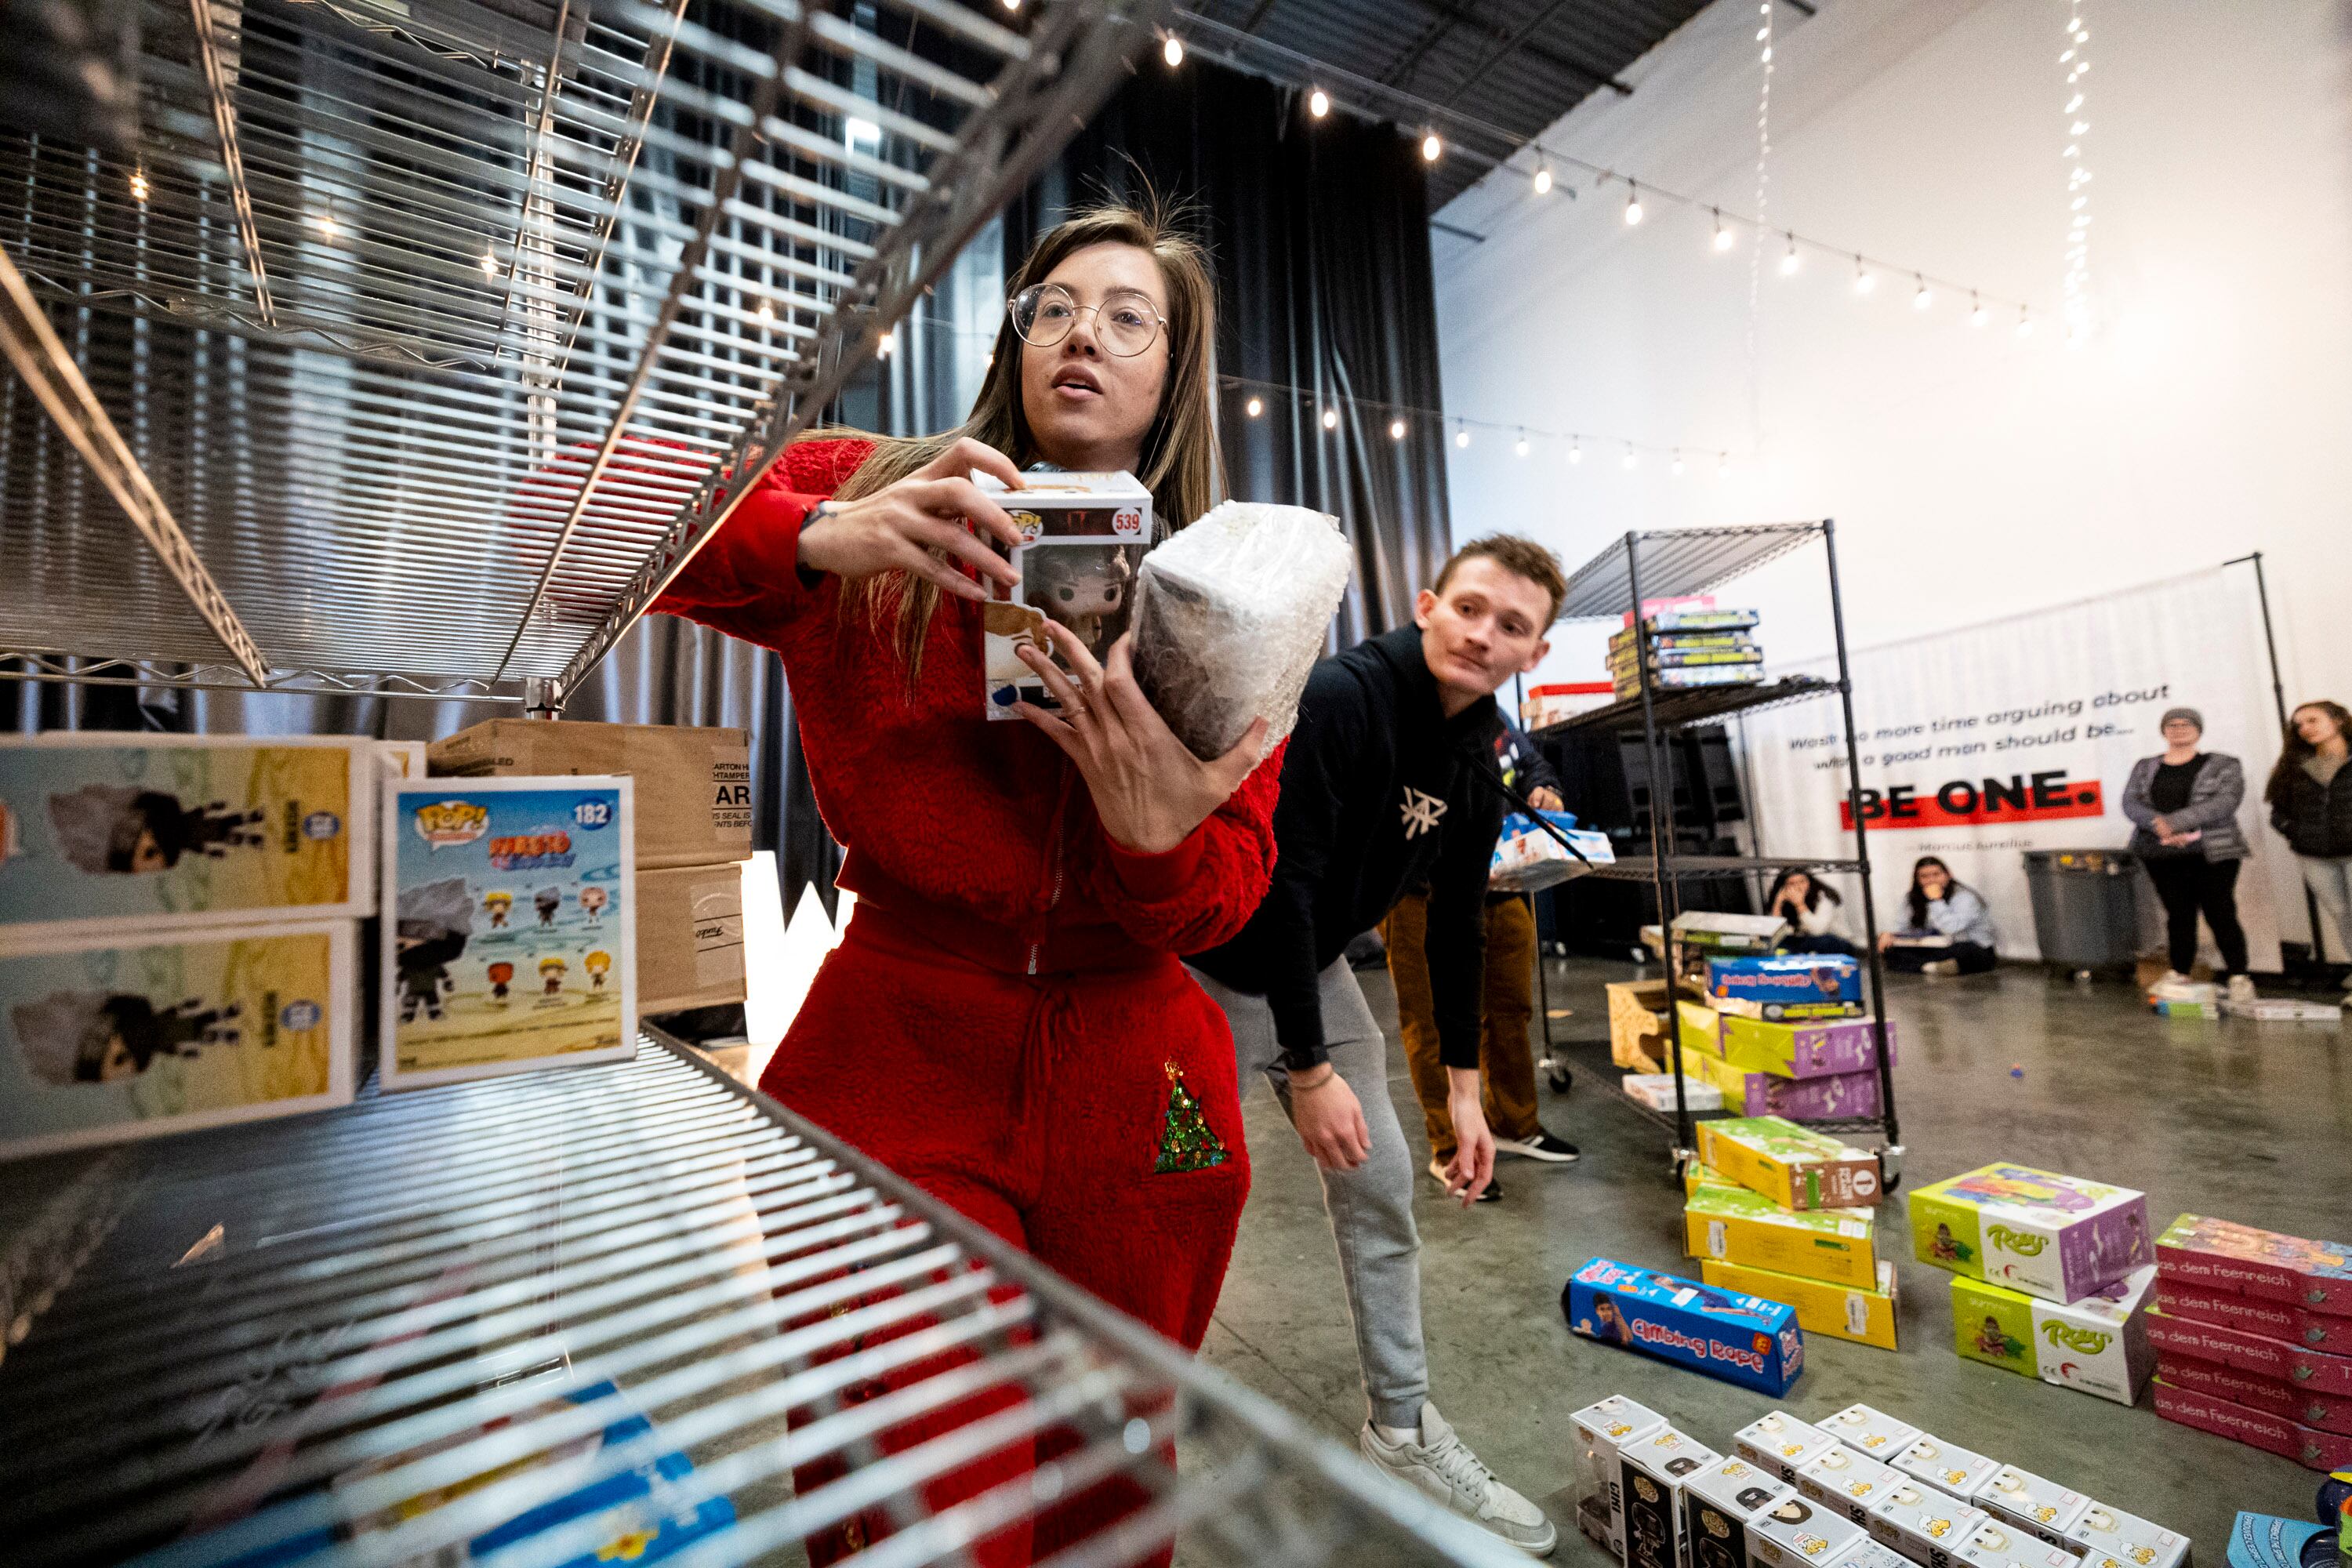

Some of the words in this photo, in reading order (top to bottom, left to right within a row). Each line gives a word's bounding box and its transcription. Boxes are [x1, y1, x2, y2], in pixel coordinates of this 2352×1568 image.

[1067, 511, 1088, 528] IT
[1116, 514, 1140, 530] 539
[1875, 724, 1926, 739] more
[1931, 717, 1979, 731] time
[1987, 699, 2083, 724] arguing
[2092, 684, 2170, 707] about
[1882, 746, 1932, 766] good
[1938, 743, 1986, 757] man
[1994, 727, 2076, 753] should
[716, 786, 750, 804] AR
[1849, 785, 1918, 821] BE
[1937, 770, 2096, 815] ONE.
[573, 804, 609, 824] 182
[2212, 1264, 2292, 1287] Feenreich
[1632, 1318, 1707, 1358] Climbing
[1709, 1339, 1764, 1373] Rope
[2201, 1334, 2280, 1363] Feenreich
[2209, 1408, 2288, 1440] Feenreich
[1780, 1465, 1795, 1486] SH
[1849, 1504, 1866, 1529] SH
